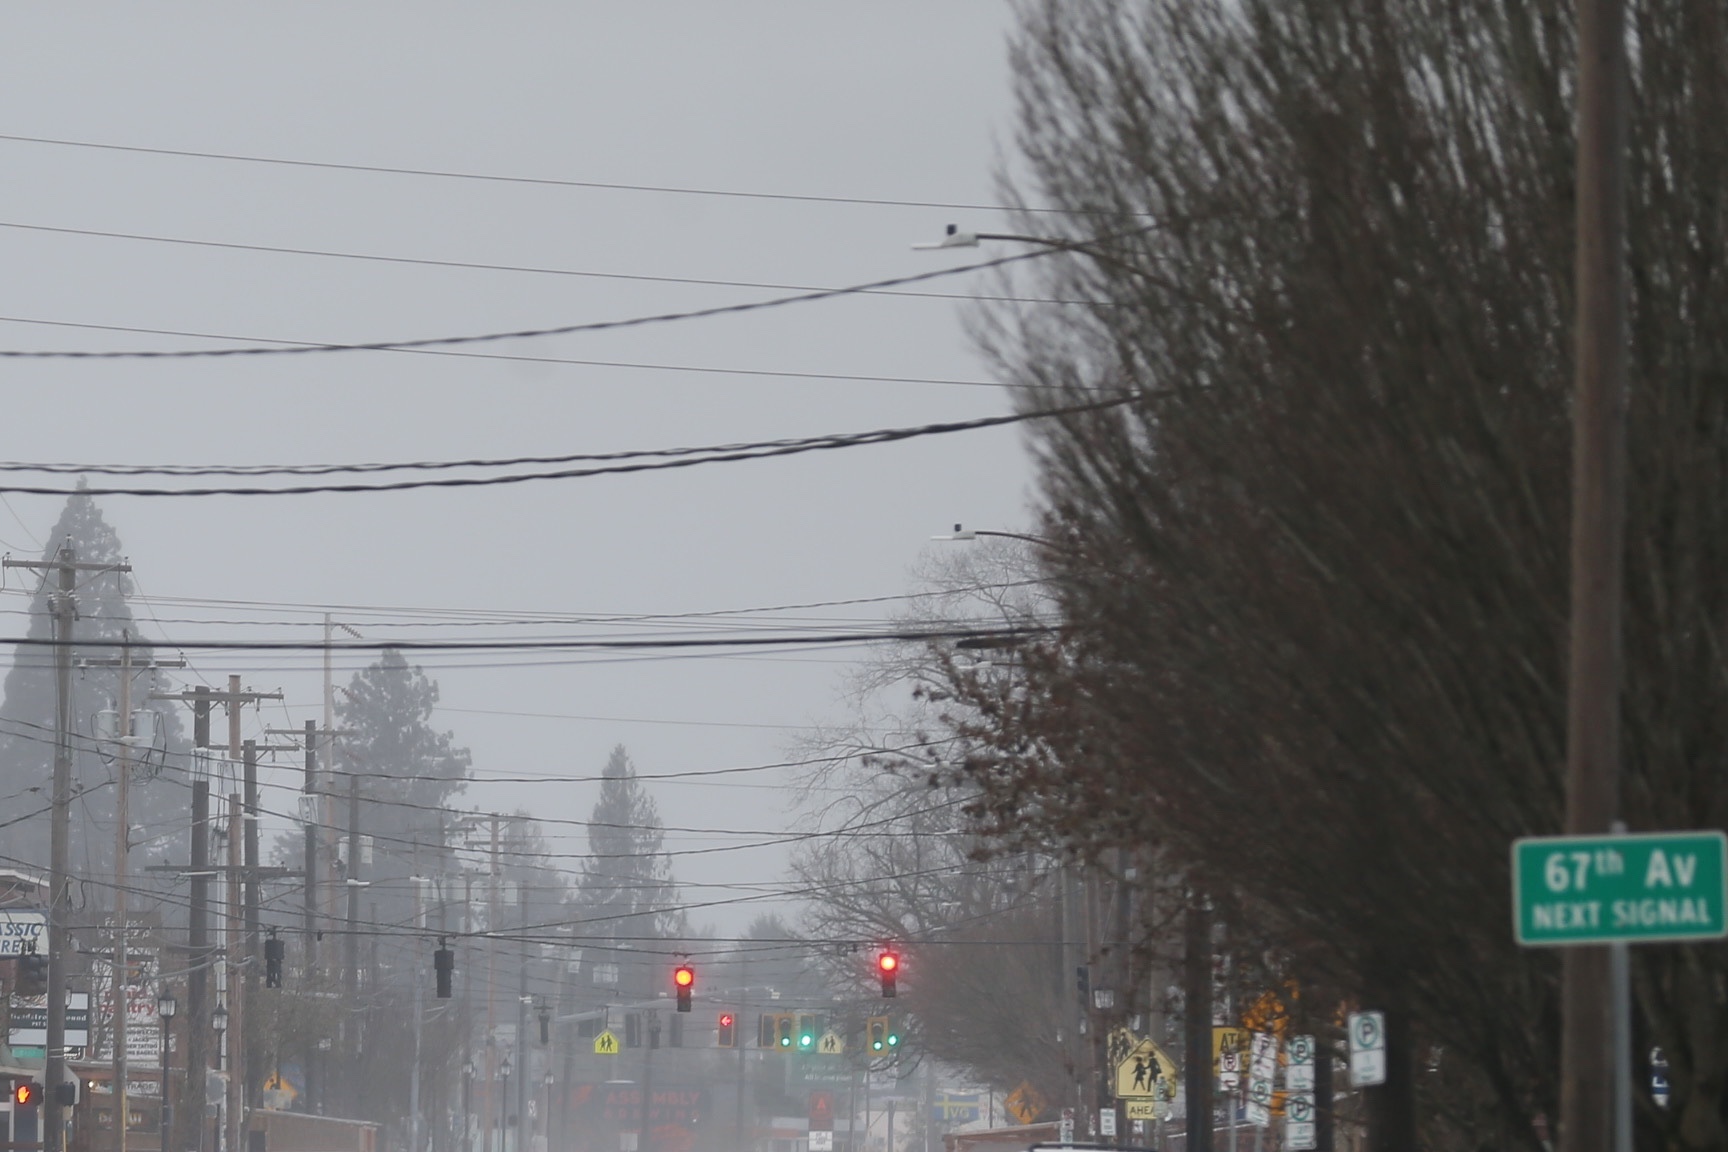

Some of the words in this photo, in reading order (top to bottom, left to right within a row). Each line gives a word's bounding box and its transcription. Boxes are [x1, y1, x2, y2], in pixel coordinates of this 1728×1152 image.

[1544, 848, 1624, 892] 67th
[1644, 848, 1697, 889] Av
[1533, 901, 1601, 930] NEXT
[1612, 897, 1712, 928] SIGNAL
[606, 1089, 700, 1105] ASSMBLY
